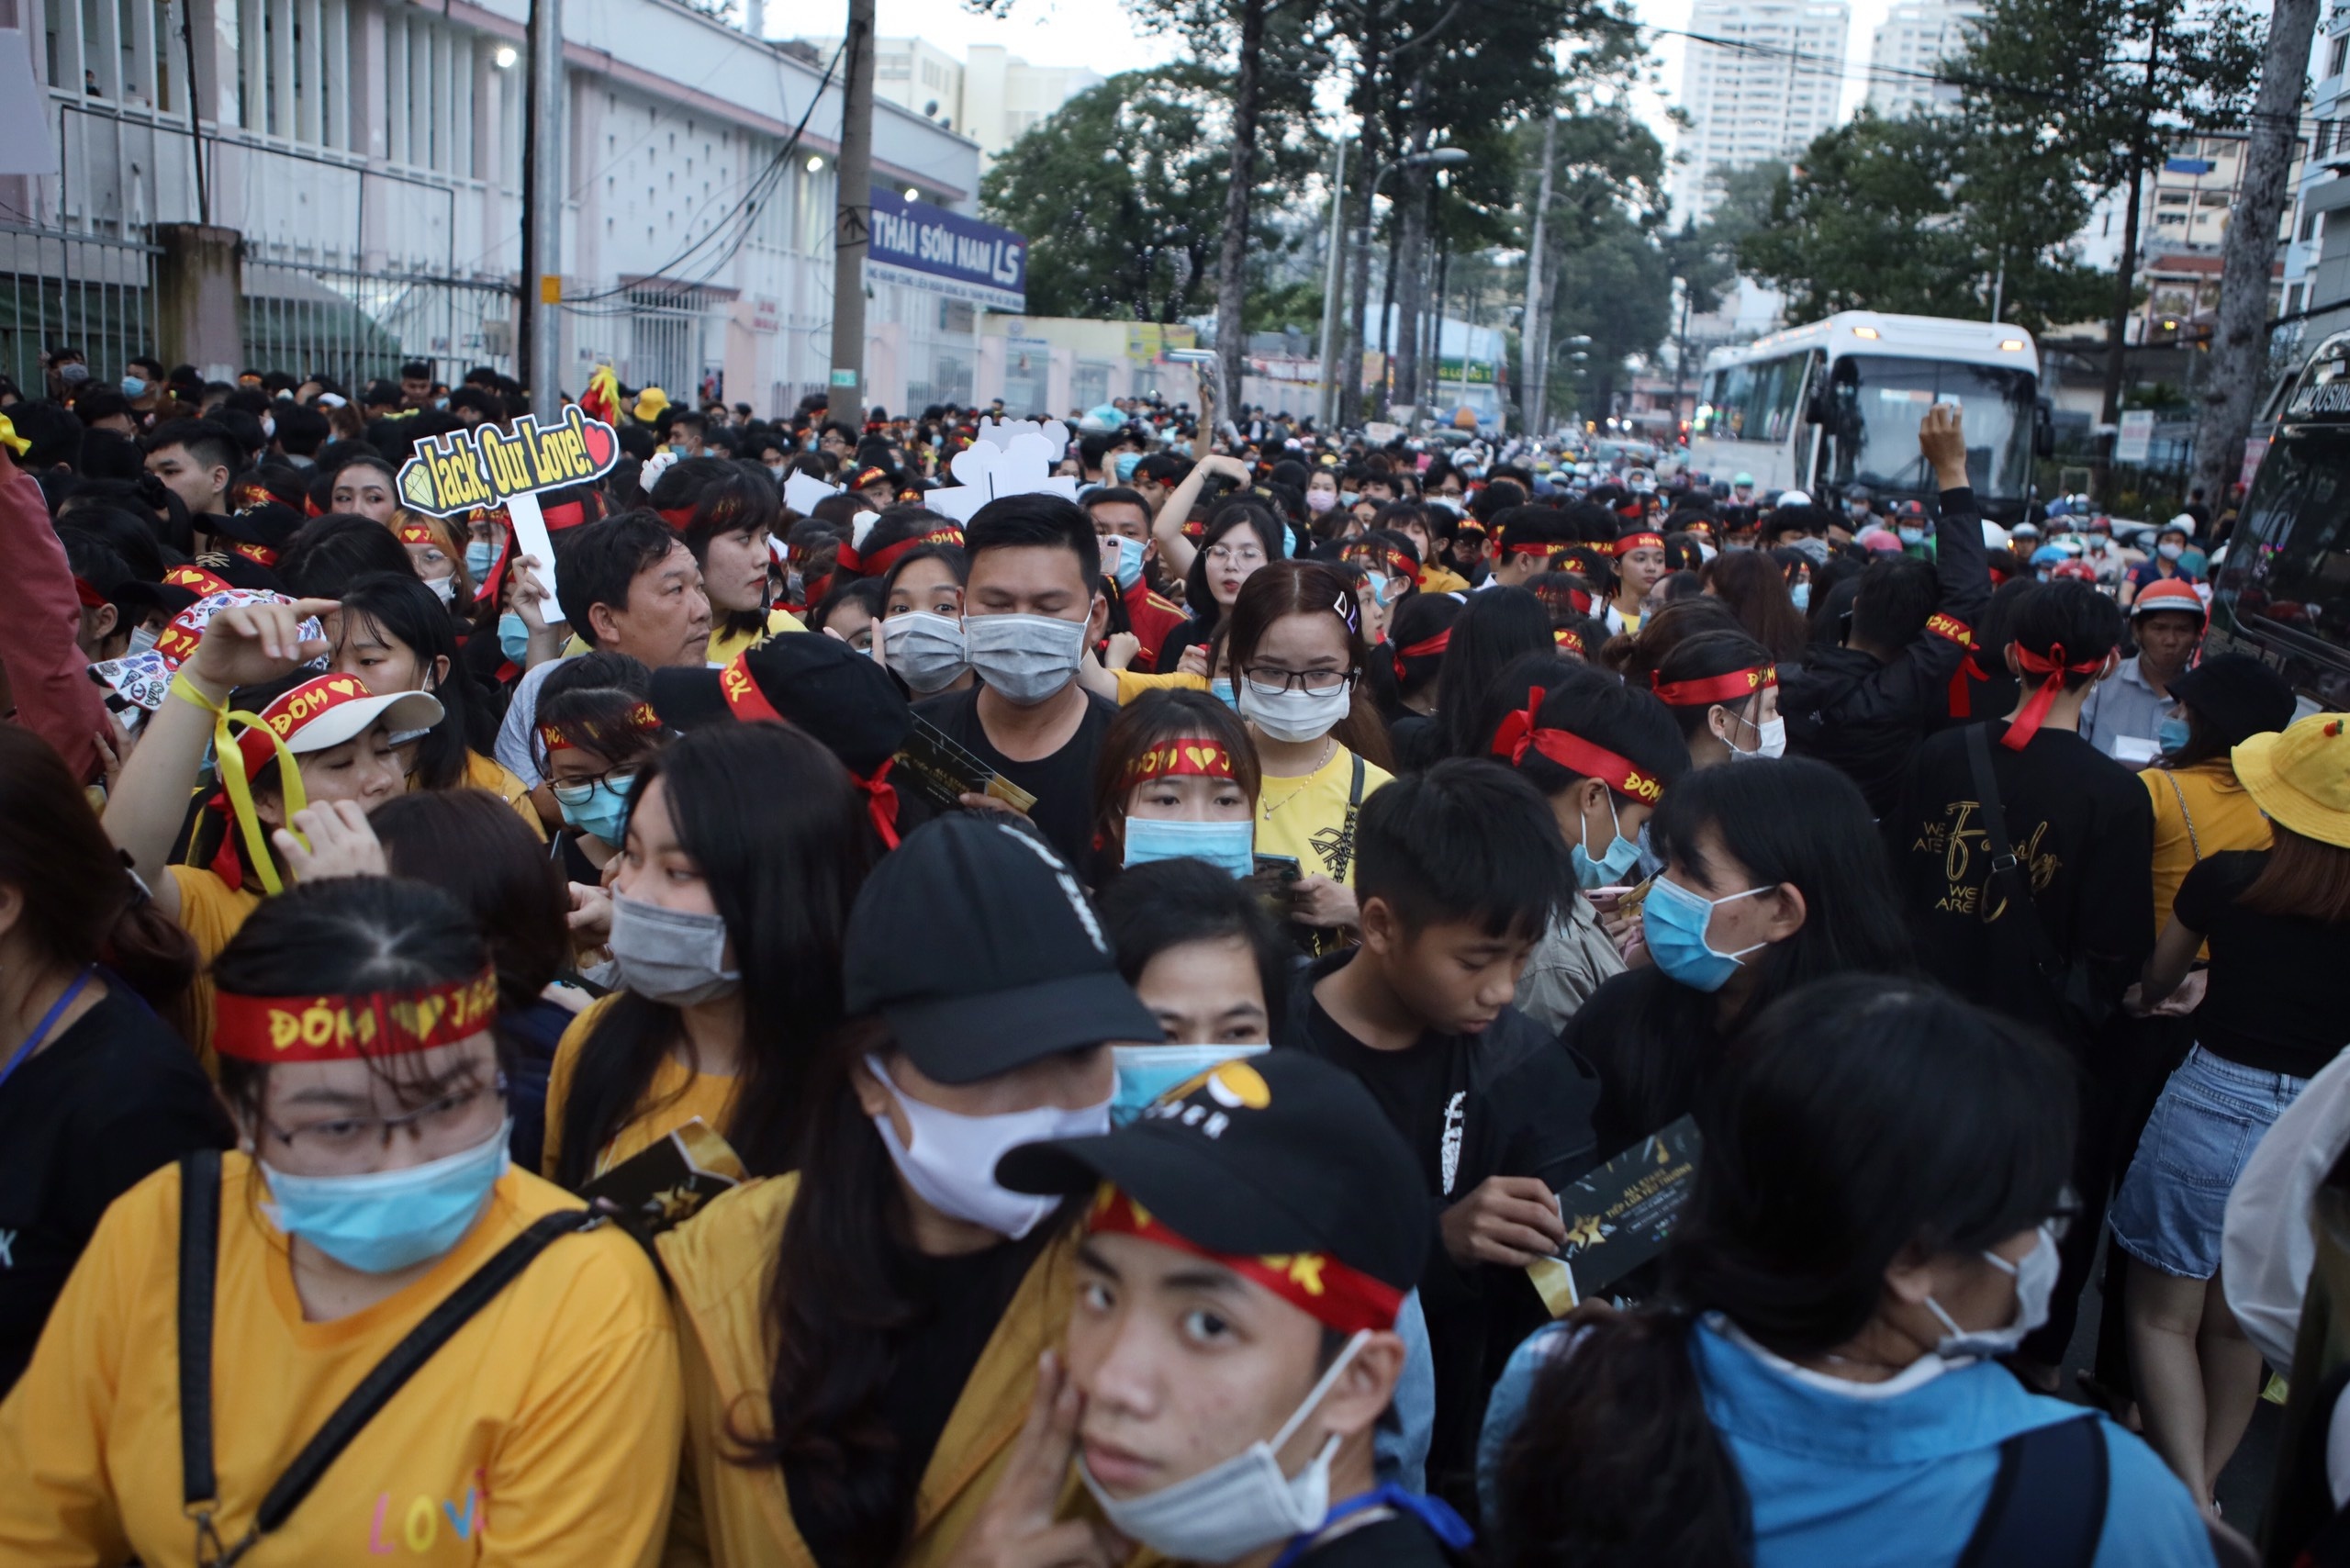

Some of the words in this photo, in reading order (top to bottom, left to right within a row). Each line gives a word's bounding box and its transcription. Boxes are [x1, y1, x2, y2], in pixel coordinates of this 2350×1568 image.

[872, 208, 917, 256] THÁI
[920, 223, 956, 265] SƠN
[957, 235, 991, 274] NAM
[992, 239, 1021, 286] LS
[423, 438, 493, 510] Jack,
[482, 430, 532, 494] Our
[521, 410, 594, 485] Love!
[269, 688, 329, 735] ĐÓM
[1623, 770, 1664, 803] ĐÓM
[1935, 897, 1975, 913] ARE
[1950, 883, 1978, 900] WE
[268, 997, 377, 1050] ĐÓM
